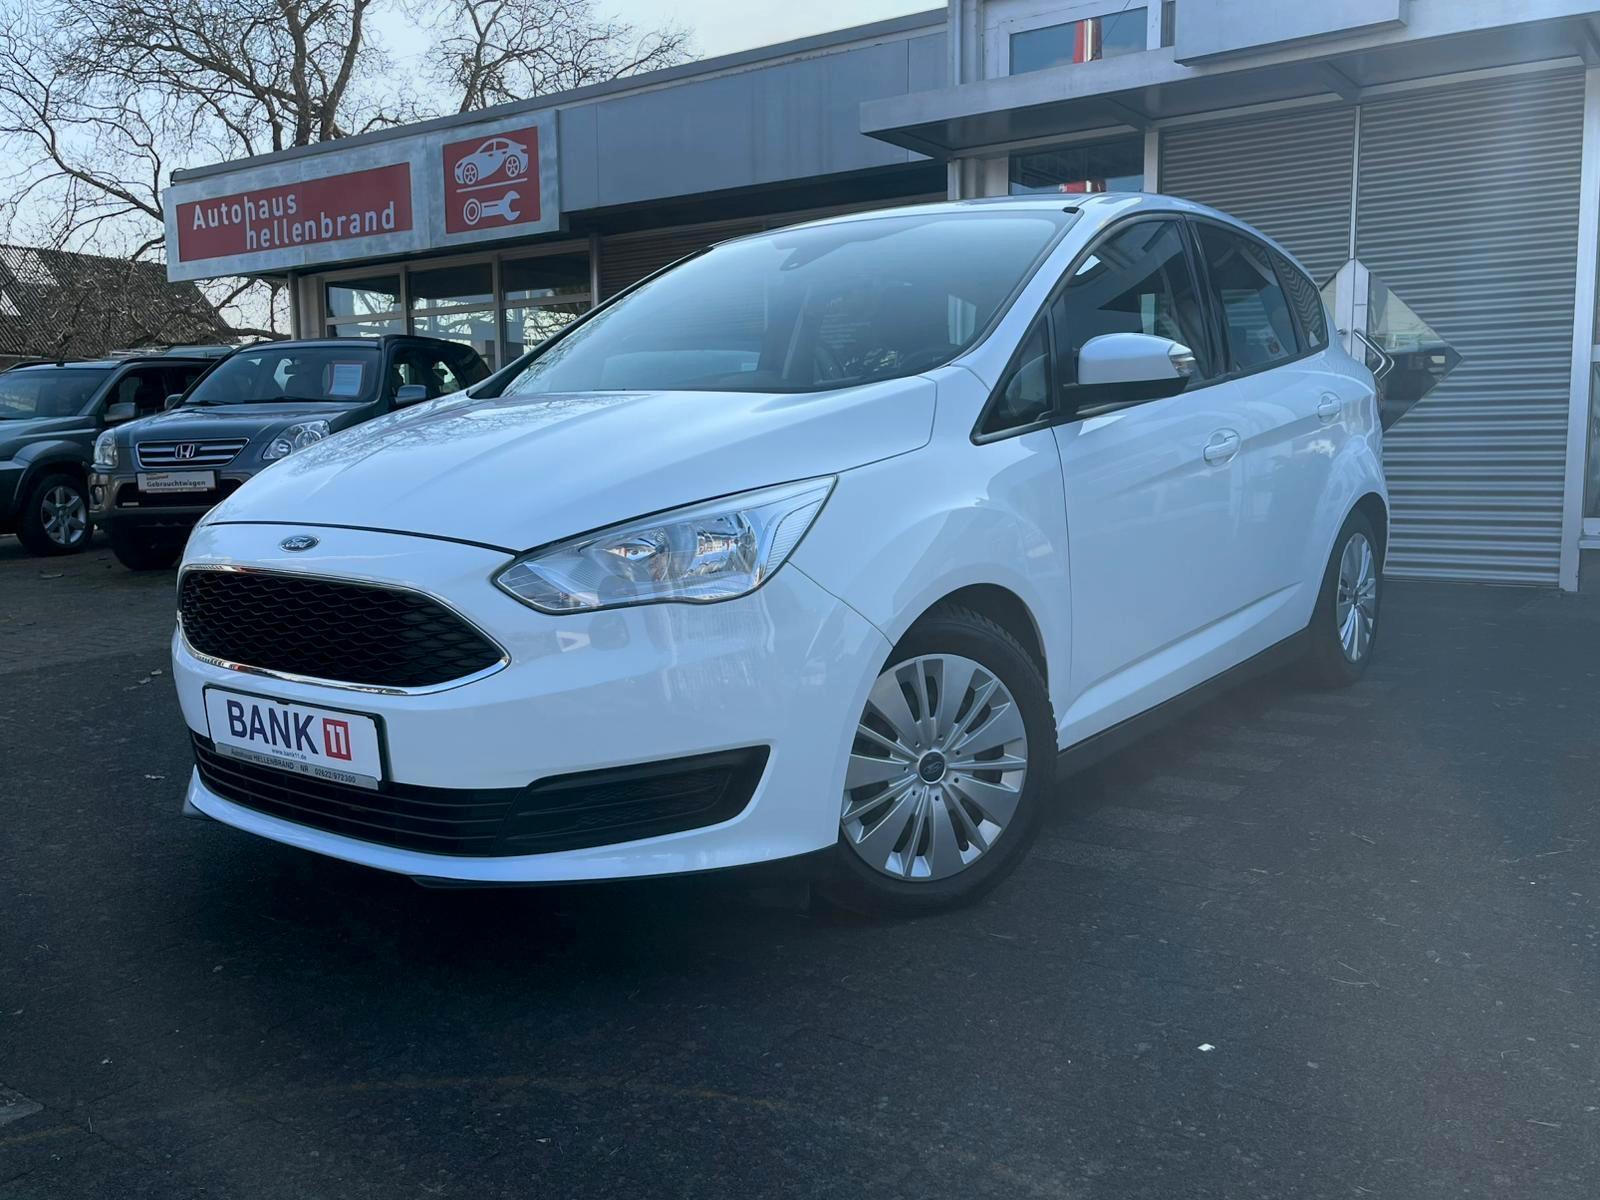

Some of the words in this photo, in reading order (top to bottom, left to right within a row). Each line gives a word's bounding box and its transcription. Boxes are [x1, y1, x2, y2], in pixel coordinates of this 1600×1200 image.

[193, 194, 297, 230] Autohaus
[246, 201, 395, 250] hellenbrand
[146, 479, 206, 488] Gebrauchtwagen
[227, 699, 319, 755] BANK
[326, 724, 348, 756] 11
[253, 754, 295, 770] HELLENBRAND
[271, 749, 307, 761] www.bank11.de
